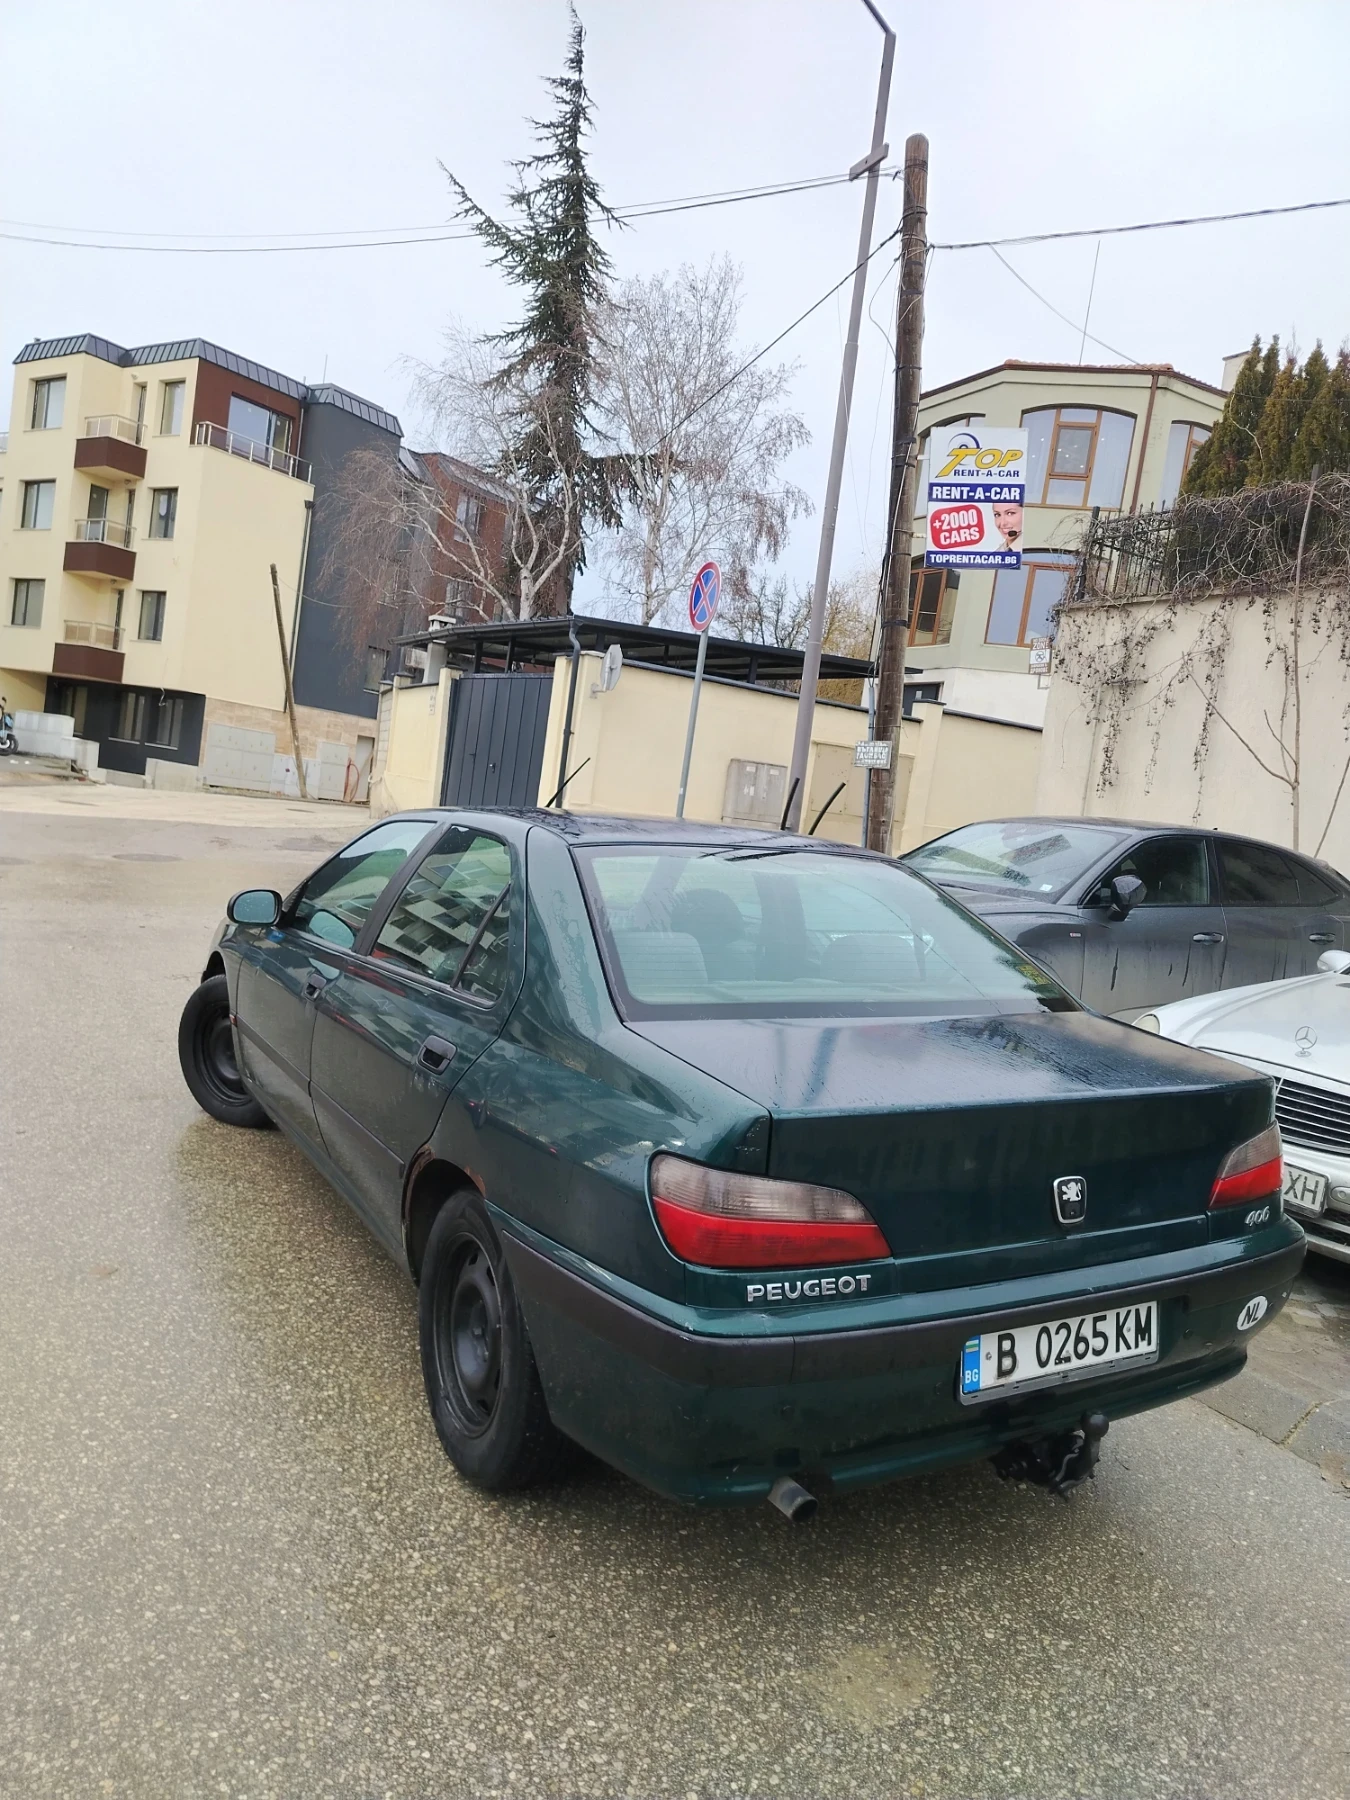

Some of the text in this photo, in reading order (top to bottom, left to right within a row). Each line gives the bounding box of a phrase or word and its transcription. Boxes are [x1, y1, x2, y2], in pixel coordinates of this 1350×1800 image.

[935, 447, 1024, 478] TOP
[953, 469, 1020, 478] RENT-A-CAR
[932, 486, 1021, 500] RENT-A-CAR
[933, 508, 979, 531] +2000
[940, 526, 980, 546] CARS
[930, 554, 1017, 565] TOPRENTACAR.BG
[1245, 1205, 1271, 1227] 406
[746, 1274, 872, 1303] PEUGEOT
[1240, 1302, 1262, 1328] NL
[965, 1369, 979, 1384] BG
